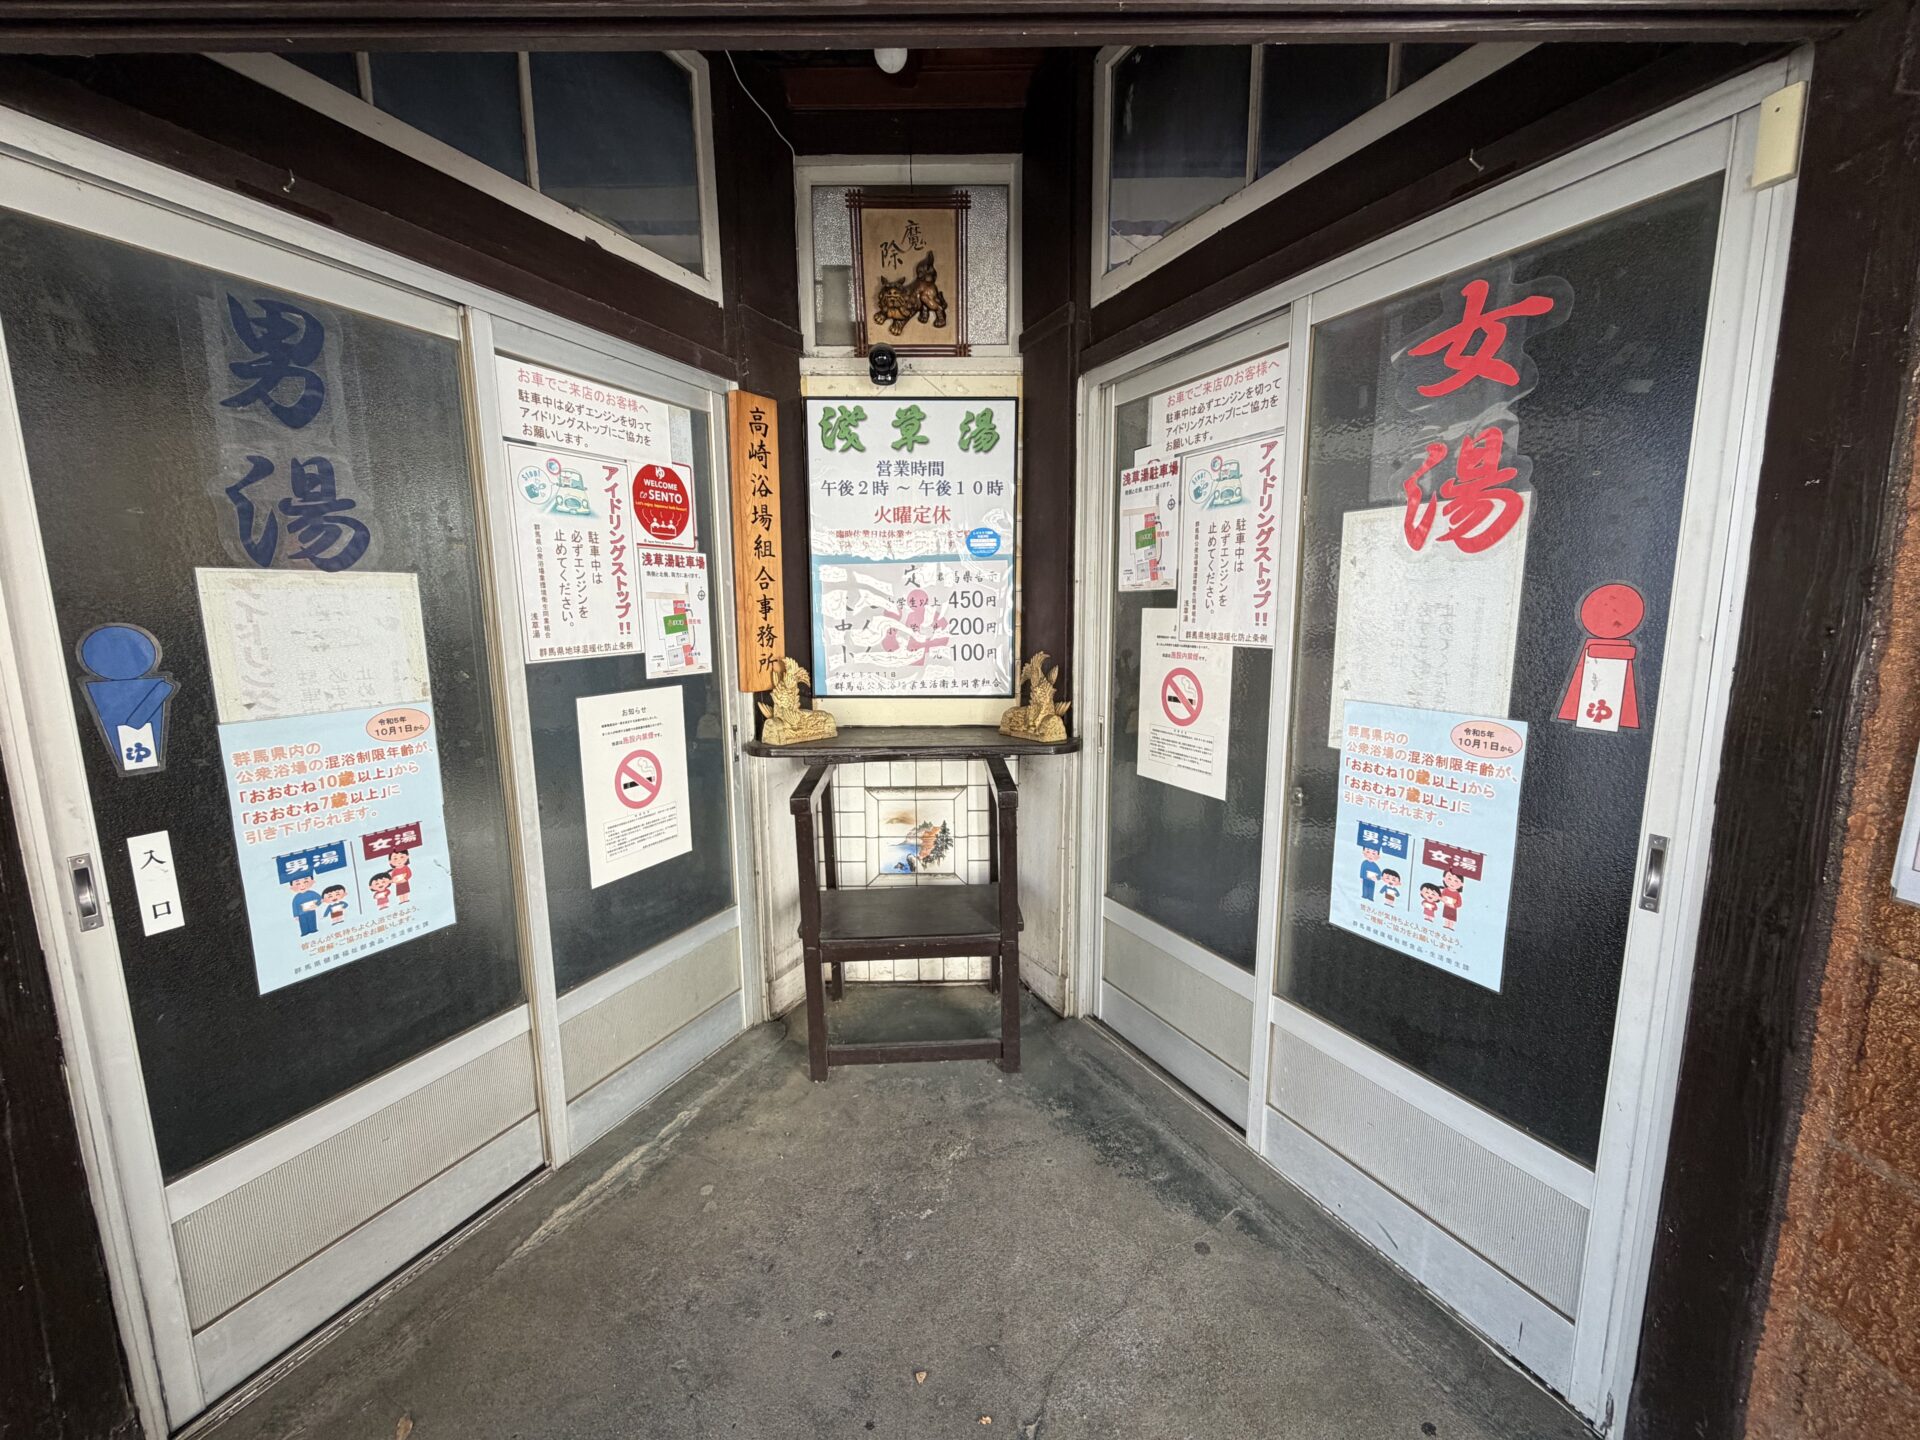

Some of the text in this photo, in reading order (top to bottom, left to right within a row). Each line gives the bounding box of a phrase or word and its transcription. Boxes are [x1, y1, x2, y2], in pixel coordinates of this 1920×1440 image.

[517, 366, 649, 415] お車でご来店のお客様へ
[1167, 360, 1280, 406] お車でご来店のお客様へ
[517, 388, 652, 433] 駐車中は必ずエンジンを切って
[1165, 377, 1282, 424] 駐車中は必ずエンジンを切って
[1165, 395, 1279, 437] アイドリングストップにご協力を
[1403, 279, 1554, 553] 女湯
[219, 292, 371, 572] 男湯
[519, 406, 652, 447] アイドリングストップにご協力を
[522, 423, 589, 448] お願いします。
[1165, 430, 1214, 452] お願いします。
[643, 478, 677, 491] WELCOME
[876, 460, 945, 478] 営業時間
[1122, 460, 1179, 487] 浅草湯駐車場
[648, 489, 683, 504] SENTO
[874, 505, 951, 525] 火曜定休
[749, 406, 777, 674] 高崎浴場組合事務所
[1234, 518, 1247, 573] 駐車中は
[588, 530, 603, 585] 駐車中は
[641, 551, 705, 570] 浅草湯駐車場
[1205, 521, 1217, 615] 止めてください。
[1218, 520, 1231, 607] 必ずエンジンを
[554, 529, 574, 627] 止めてください。
[571, 530, 588, 618] 必ずエンジンを
[949, 590, 997, 608] 450円
[949, 617, 997, 636] 200円
[950, 643, 997, 662] 100円
[378, 716, 408, 726] 令和5年
[622, 706, 646, 717] お知らせ
[1586, 699, 1613, 723] ゆ
[374, 723, 426, 738] 10月1日から
[1348, 725, 1409, 746] 群馬県内の
[1457, 736, 1514, 754] 10月1日から
[1463, 728, 1495, 739] 令和5年
[126, 741, 152, 763] ゆ
[231, 741, 321, 767] 群馬県内の
[236, 739, 433, 786] 公衆浴場の混浴制限年齢が、
[1346, 741, 1519, 784] 公衆浴場の混浴制限年齢が、
[238, 761, 420, 805] 「おおむね10歳以上」から
[1344, 757, 1496, 799] 「おおむね10歳以上」から
[241, 784, 401, 825] 「おおむね7歳以上」に
[1342, 775, 1471, 815] 「おおむね7歳以上」に
[1344, 790, 1444, 827] 引き下げられます。
[245, 807, 379, 845] 引き下げられます。
[368, 829, 417, 852] 女湯
[1362, 828, 1402, 851] 男湯
[285, 850, 339, 876] 男湯
[1428, 848, 1478, 872] 女湯
[141, 848, 172, 919] 入口
